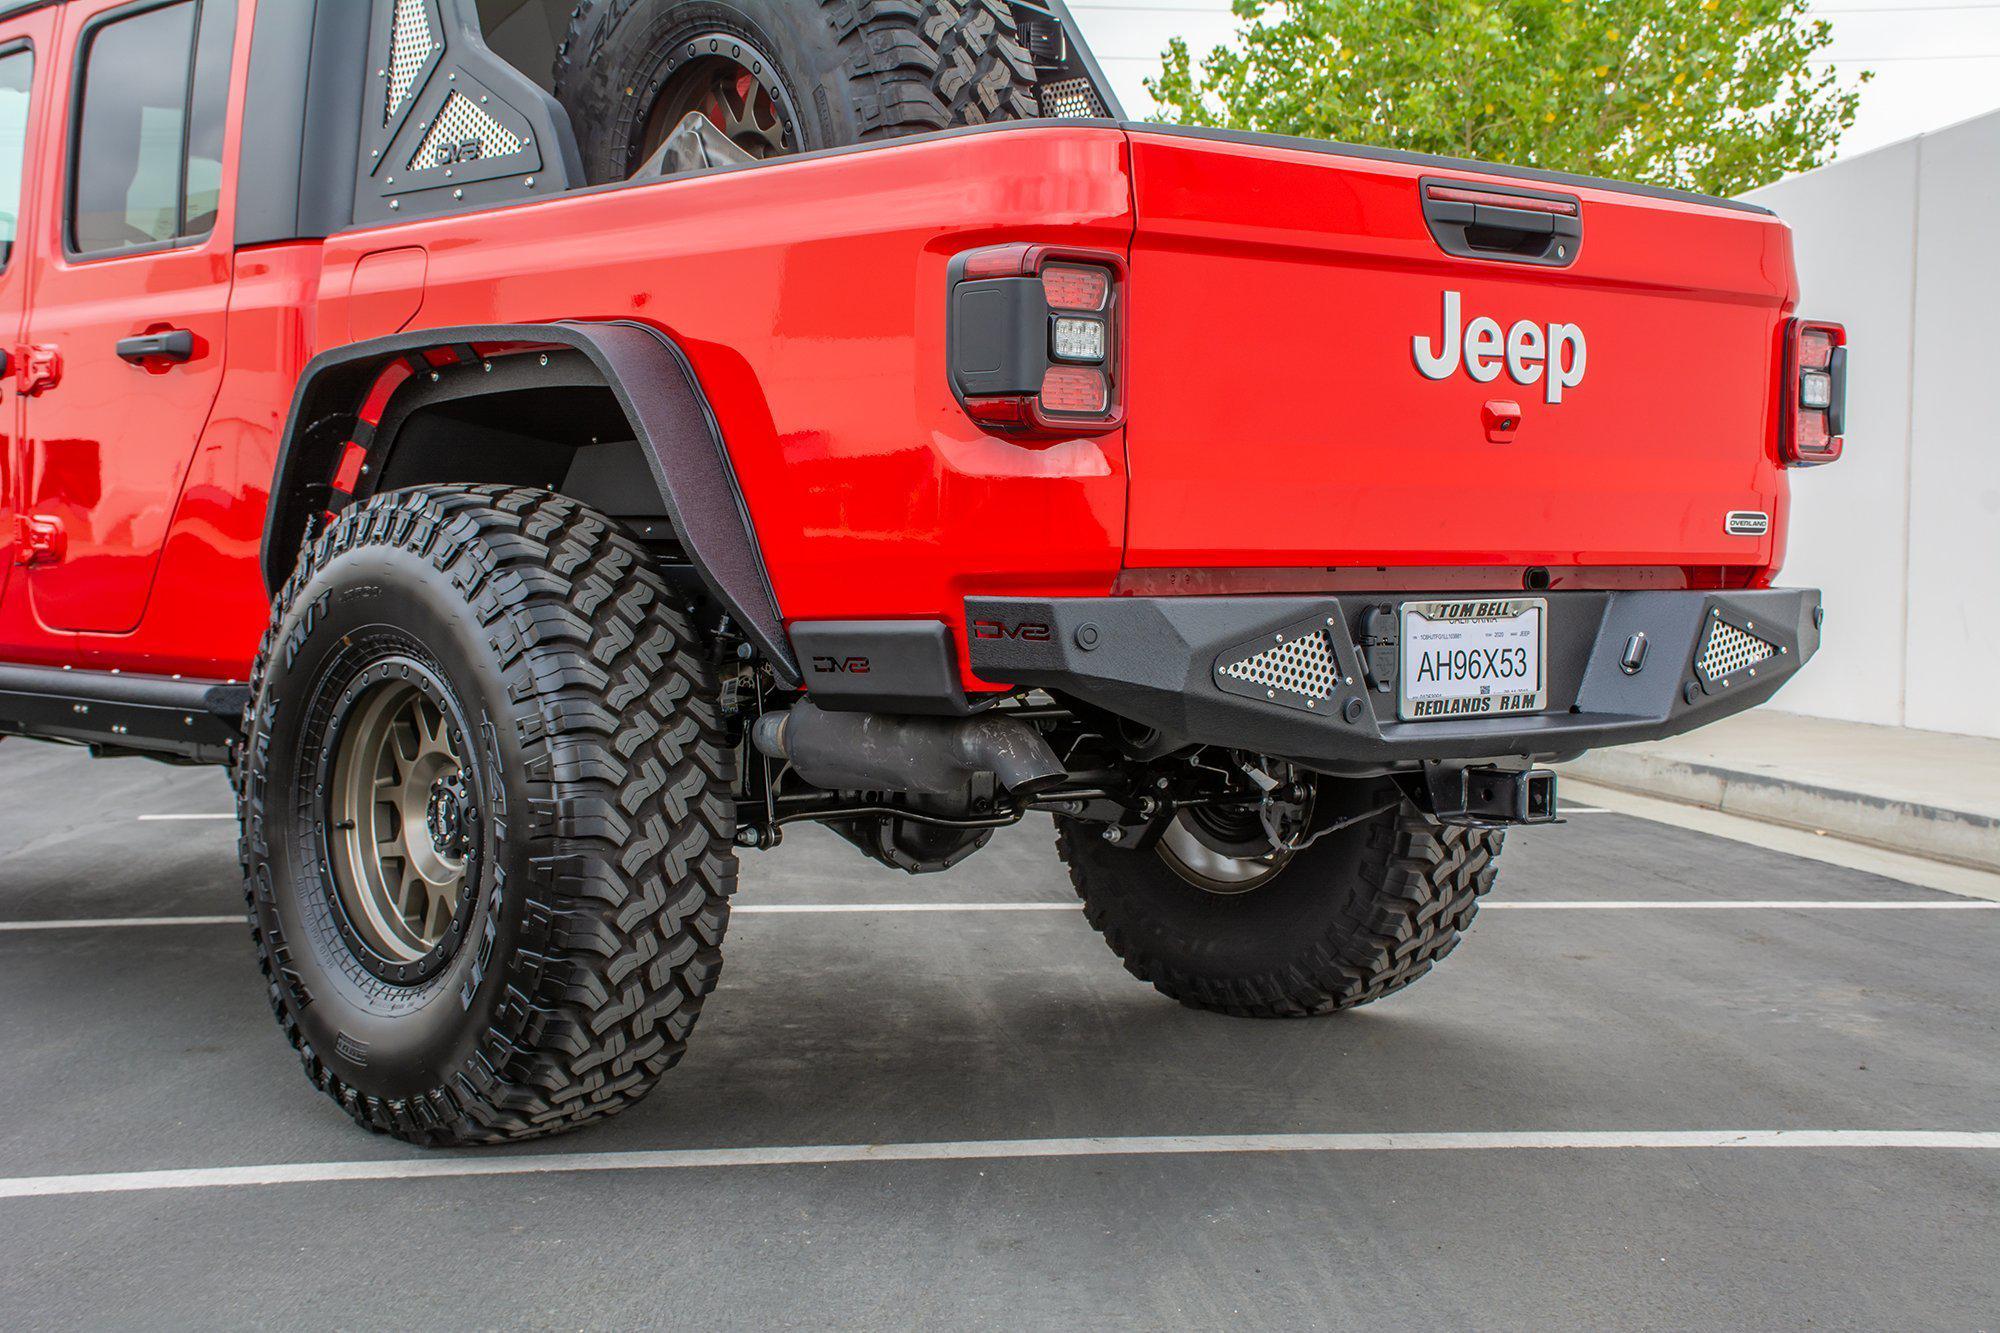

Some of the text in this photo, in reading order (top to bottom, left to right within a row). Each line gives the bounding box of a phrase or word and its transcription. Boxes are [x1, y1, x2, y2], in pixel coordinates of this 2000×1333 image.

[1412, 290, 1587, 404] Jeep
[1730, 519, 1767, 527] OVERLAND
[1439, 602, 1509, 618] TOM BELL
[1416, 647, 1527, 682] AH96X53
[1413, 694, 1536, 716] REDLANDS RAM
